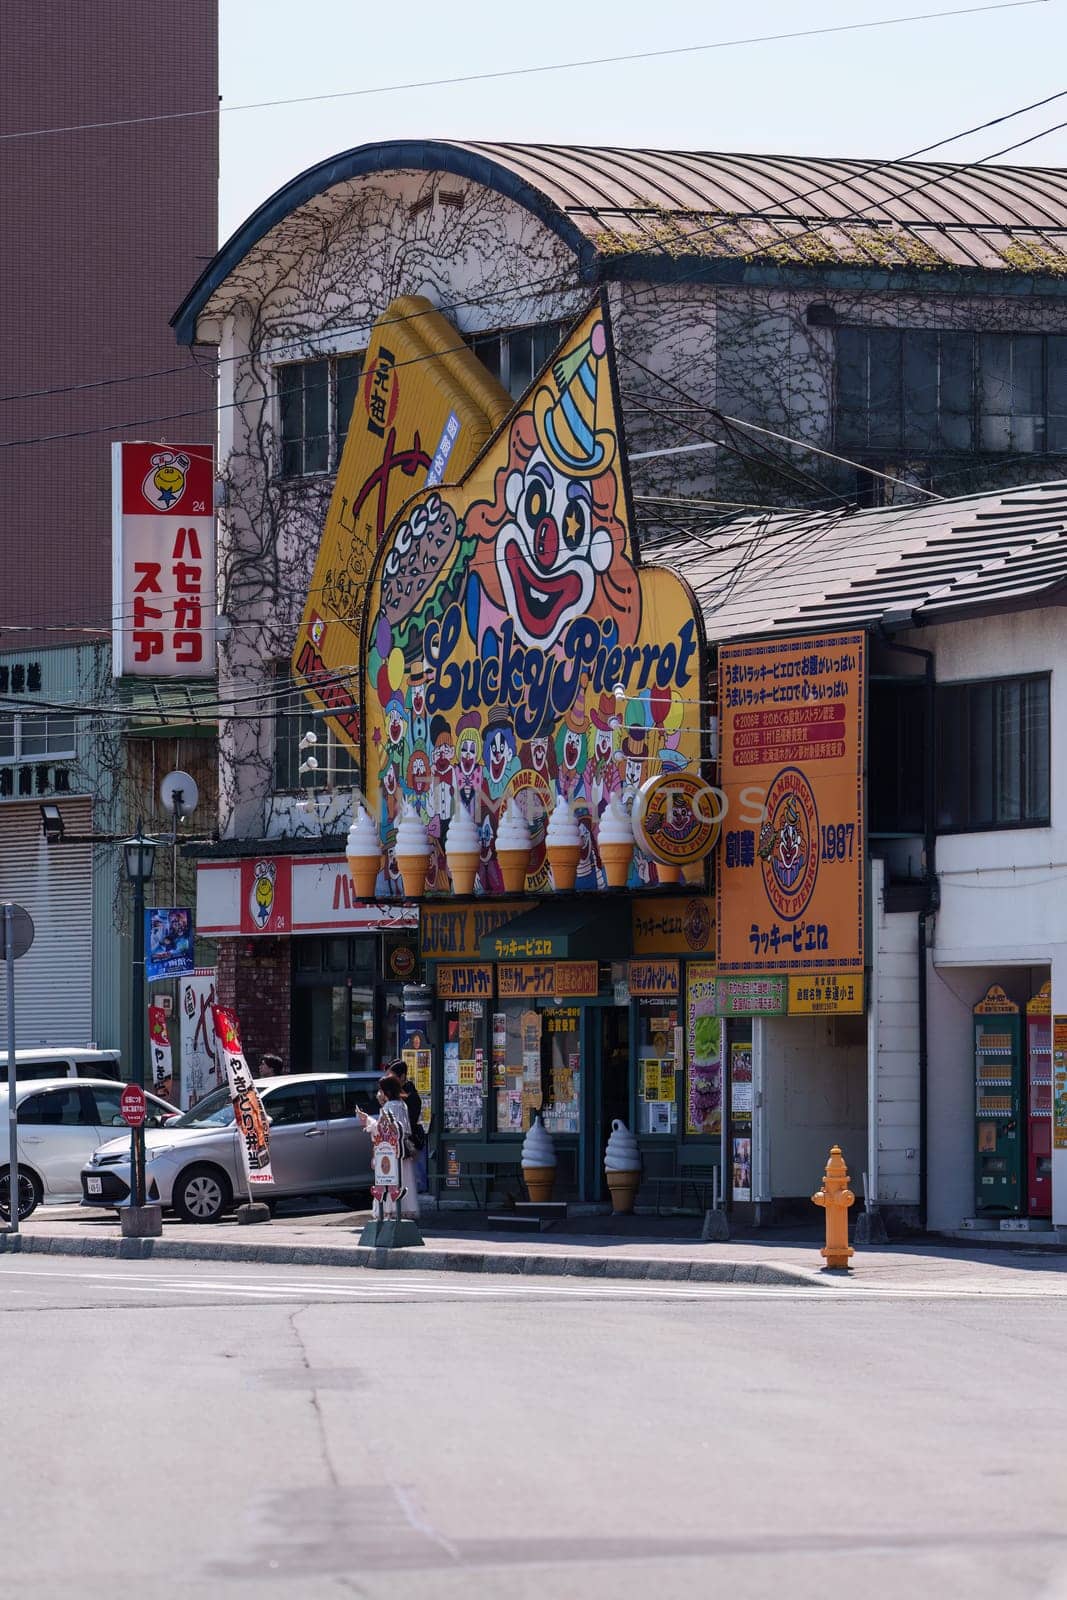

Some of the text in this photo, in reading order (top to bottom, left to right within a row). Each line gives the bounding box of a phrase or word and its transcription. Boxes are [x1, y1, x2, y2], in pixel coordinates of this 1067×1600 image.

[371, 363, 389, 422] 元祖
[192, 501, 205, 512] 24
[133, 562, 164, 662] ストア
[172, 528, 202, 662] ハセガワ
[422, 601, 555, 740] Lucky
[550, 614, 697, 713] Pierrot
[512, 771, 532, 789] MADE
[821, 823, 855, 864] 1987
[766, 869, 791, 913] LUCKY
[276, 916, 285, 929] 24
[749, 921, 829, 955] ラッキーピエロ
[495, 938, 552, 957] ラッキーピエロ
[230, 1057, 259, 1170] やきとり弁当
